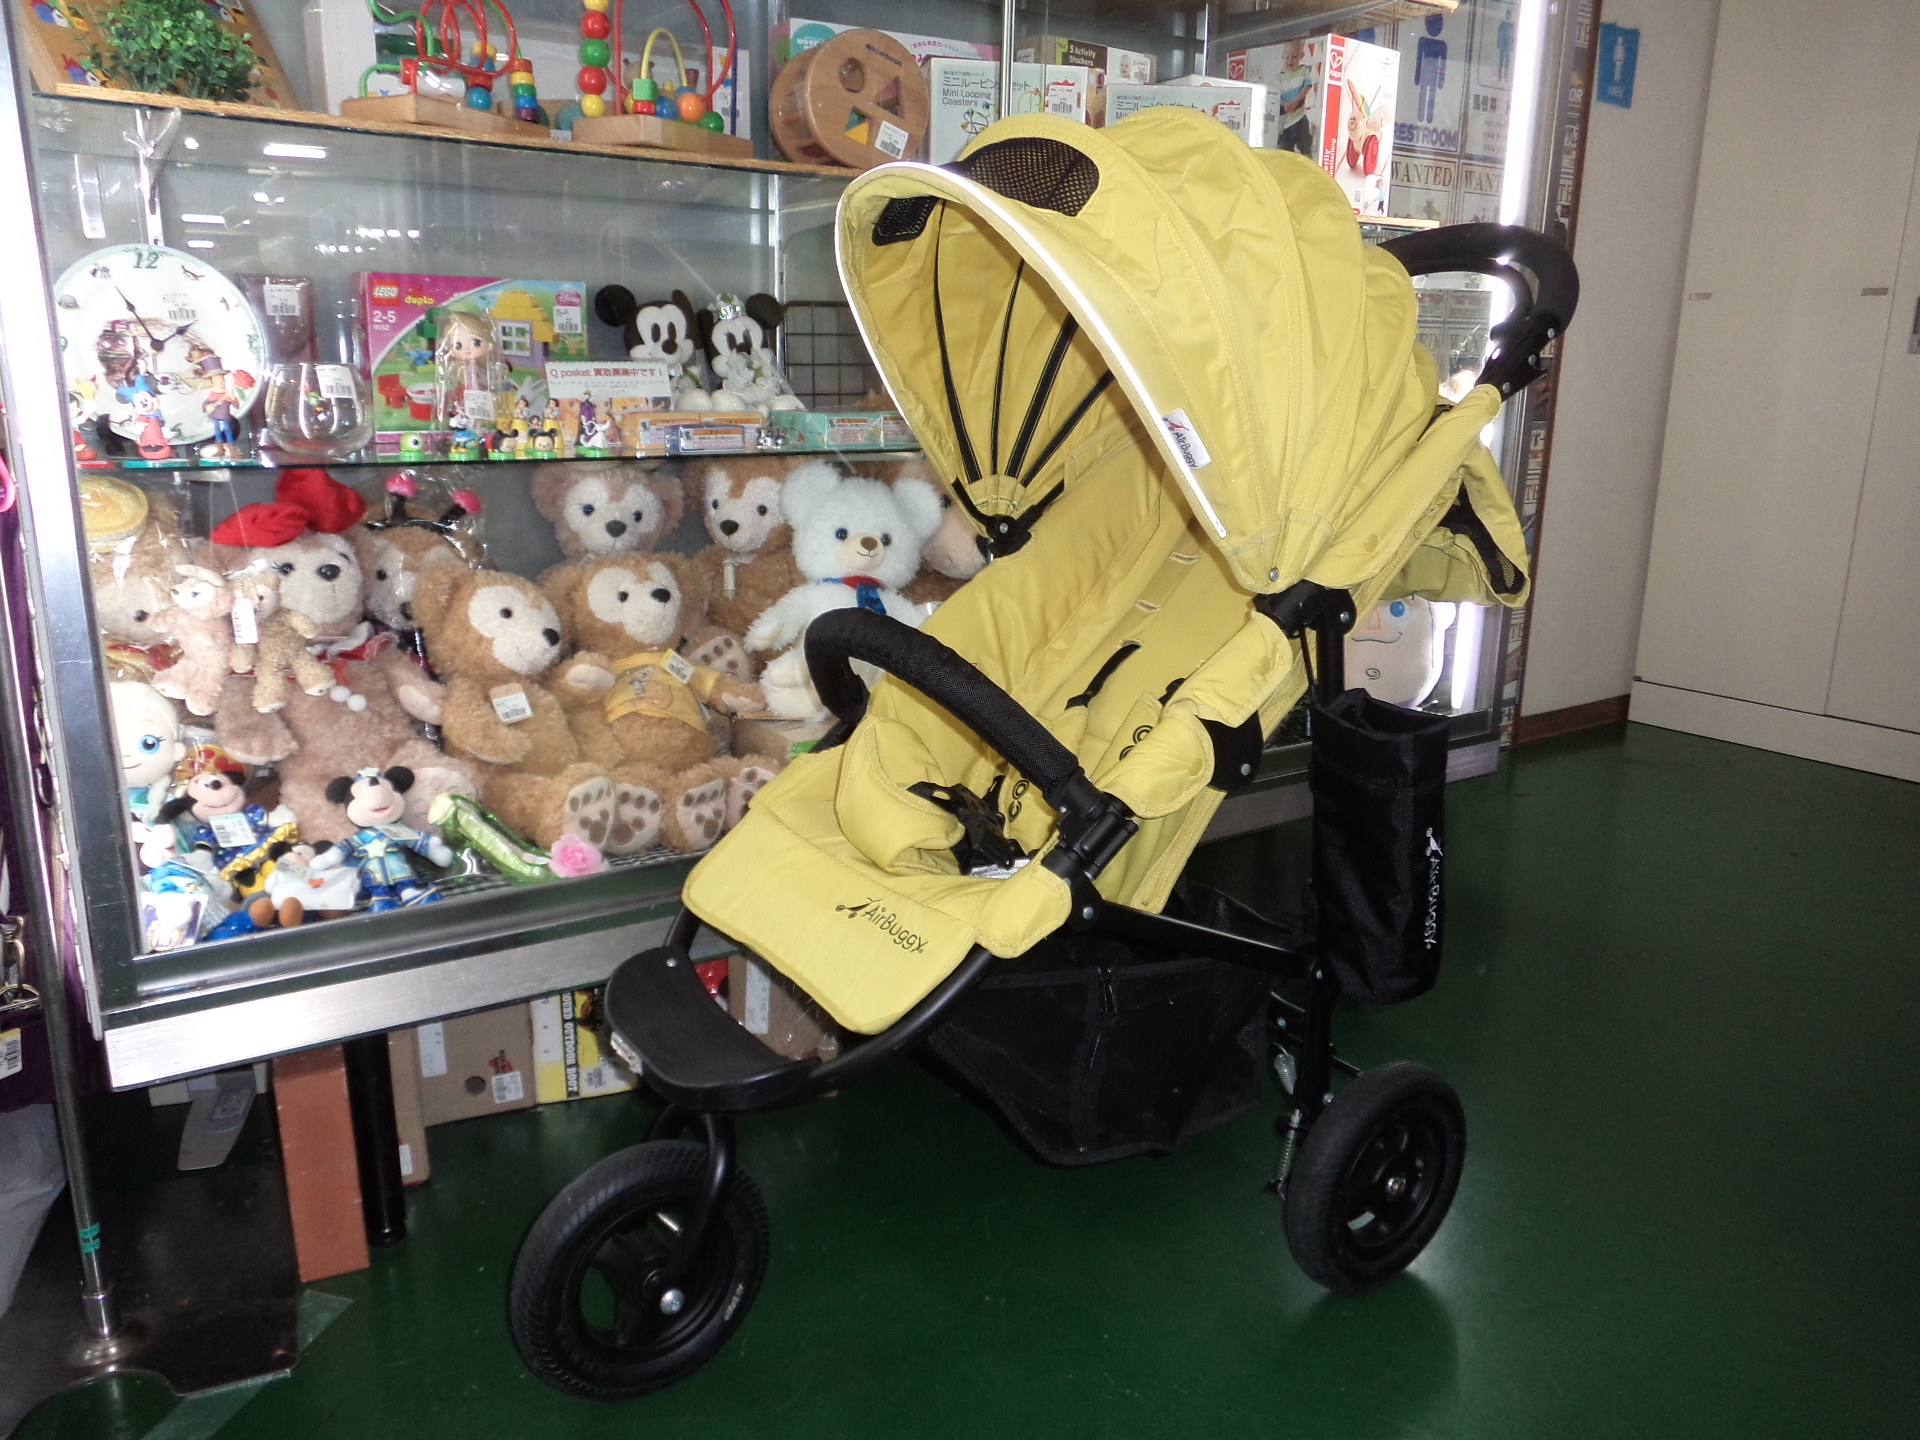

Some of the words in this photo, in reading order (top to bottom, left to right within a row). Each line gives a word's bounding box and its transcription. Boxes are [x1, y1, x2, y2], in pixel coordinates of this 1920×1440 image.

[1069, 44, 1074, 53] 5
[1074, 46, 1096, 59] Activity
[942, 88, 959, 97] Mini
[961, 89, 992, 100] Looping
[942, 97, 978, 107] Coasters
[1391, 160, 1452, 187] WANTED
[1465, 170, 1502, 192] WANT
[133, 251, 159, 270] 12
[373, 285, 398, 299] LEGO
[405, 293, 435, 306] duplo
[372, 310, 397, 324] 2-5
[551, 369, 558, 378] Q
[560, 369, 592, 379] posket
[1173, 431, 1198, 468] AirBuggy
[861, 904, 929, 954] AirBuggy
[563, 1021, 577, 1067] OUTDOOR
[566, 1067, 578, 1093] BOOT
